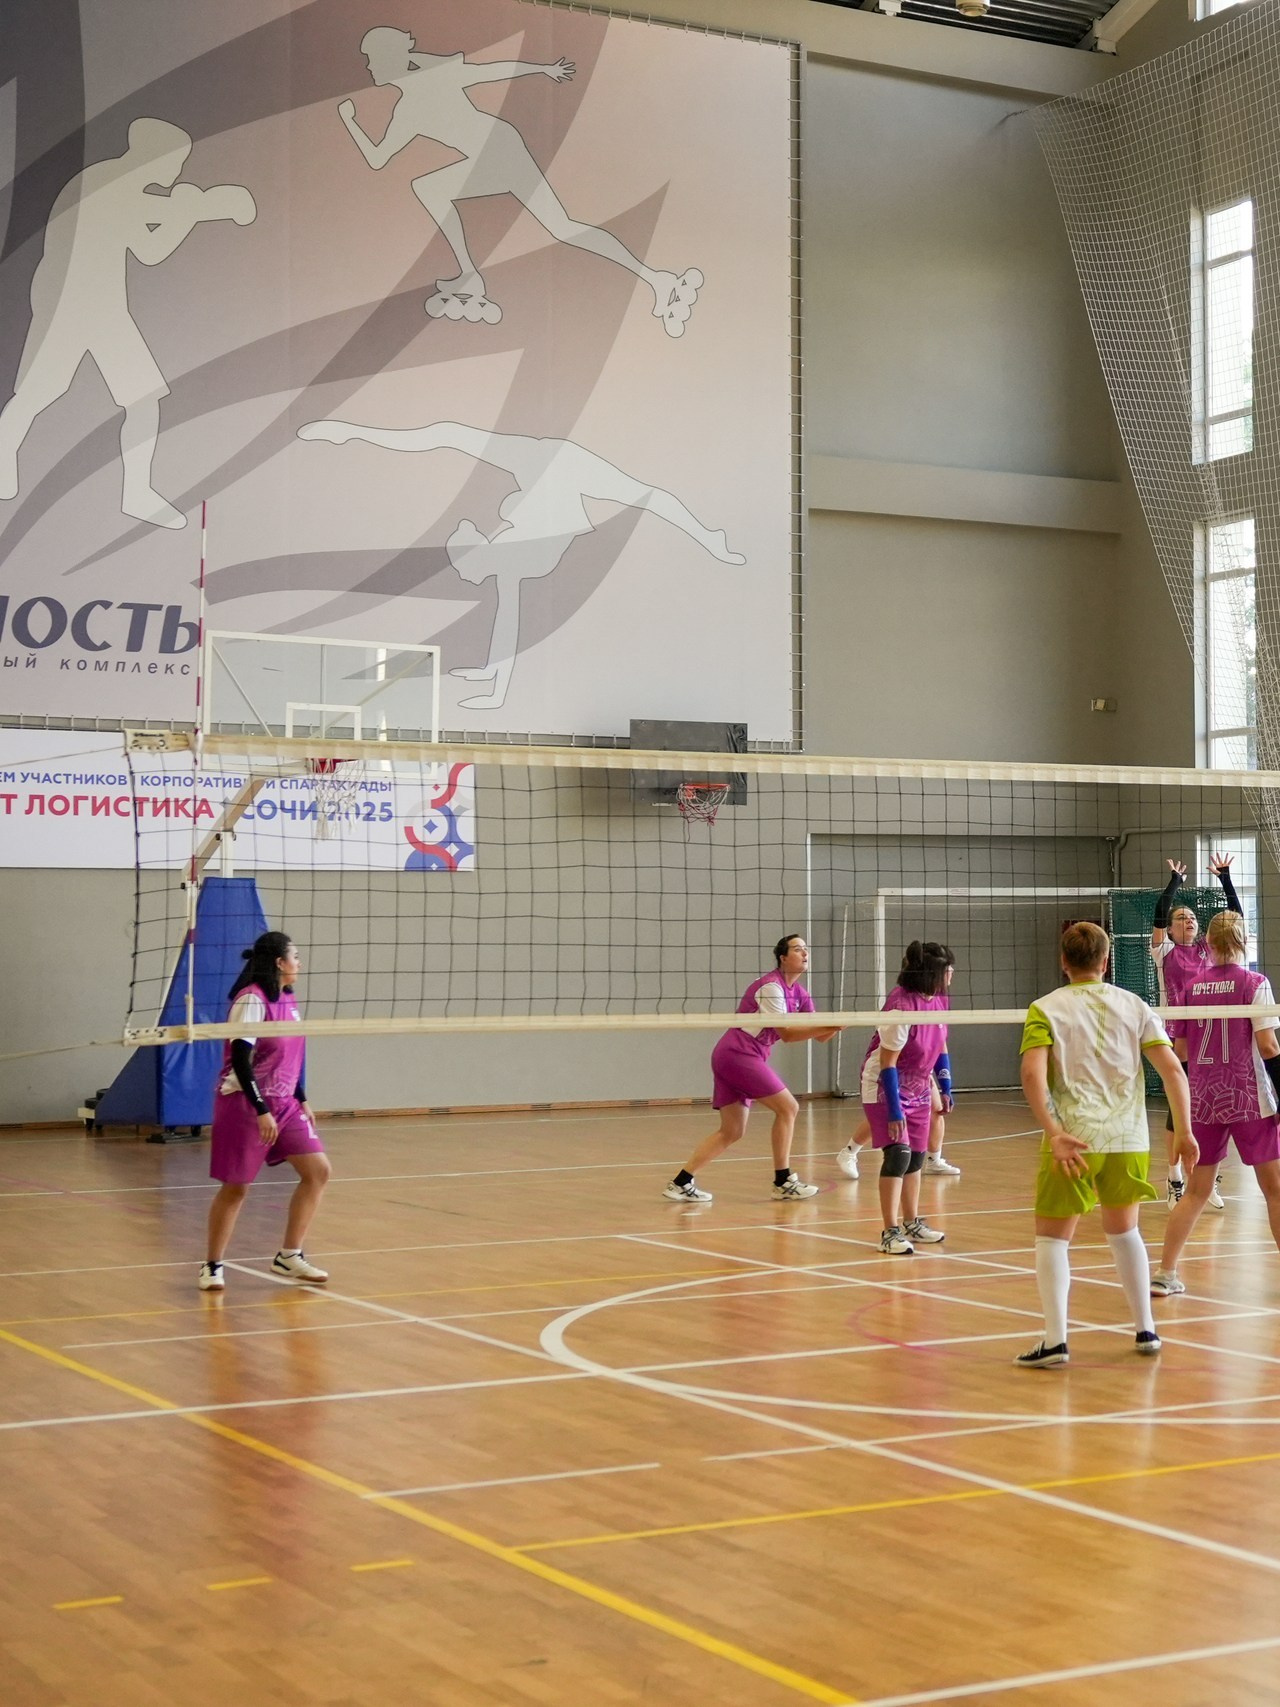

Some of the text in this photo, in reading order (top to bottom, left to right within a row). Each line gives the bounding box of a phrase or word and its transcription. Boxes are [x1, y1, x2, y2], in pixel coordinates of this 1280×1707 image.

[60, 658, 191, 675] комплекс
[20, 772, 128, 786] УЧАСТНИКОВ
[140, 774, 276, 789] КОРПОРАТИВЙ
[24, 794, 215, 819] ЛОГИСТИКА
[1192, 980, 1236, 997] КОЧЕТКОВА
